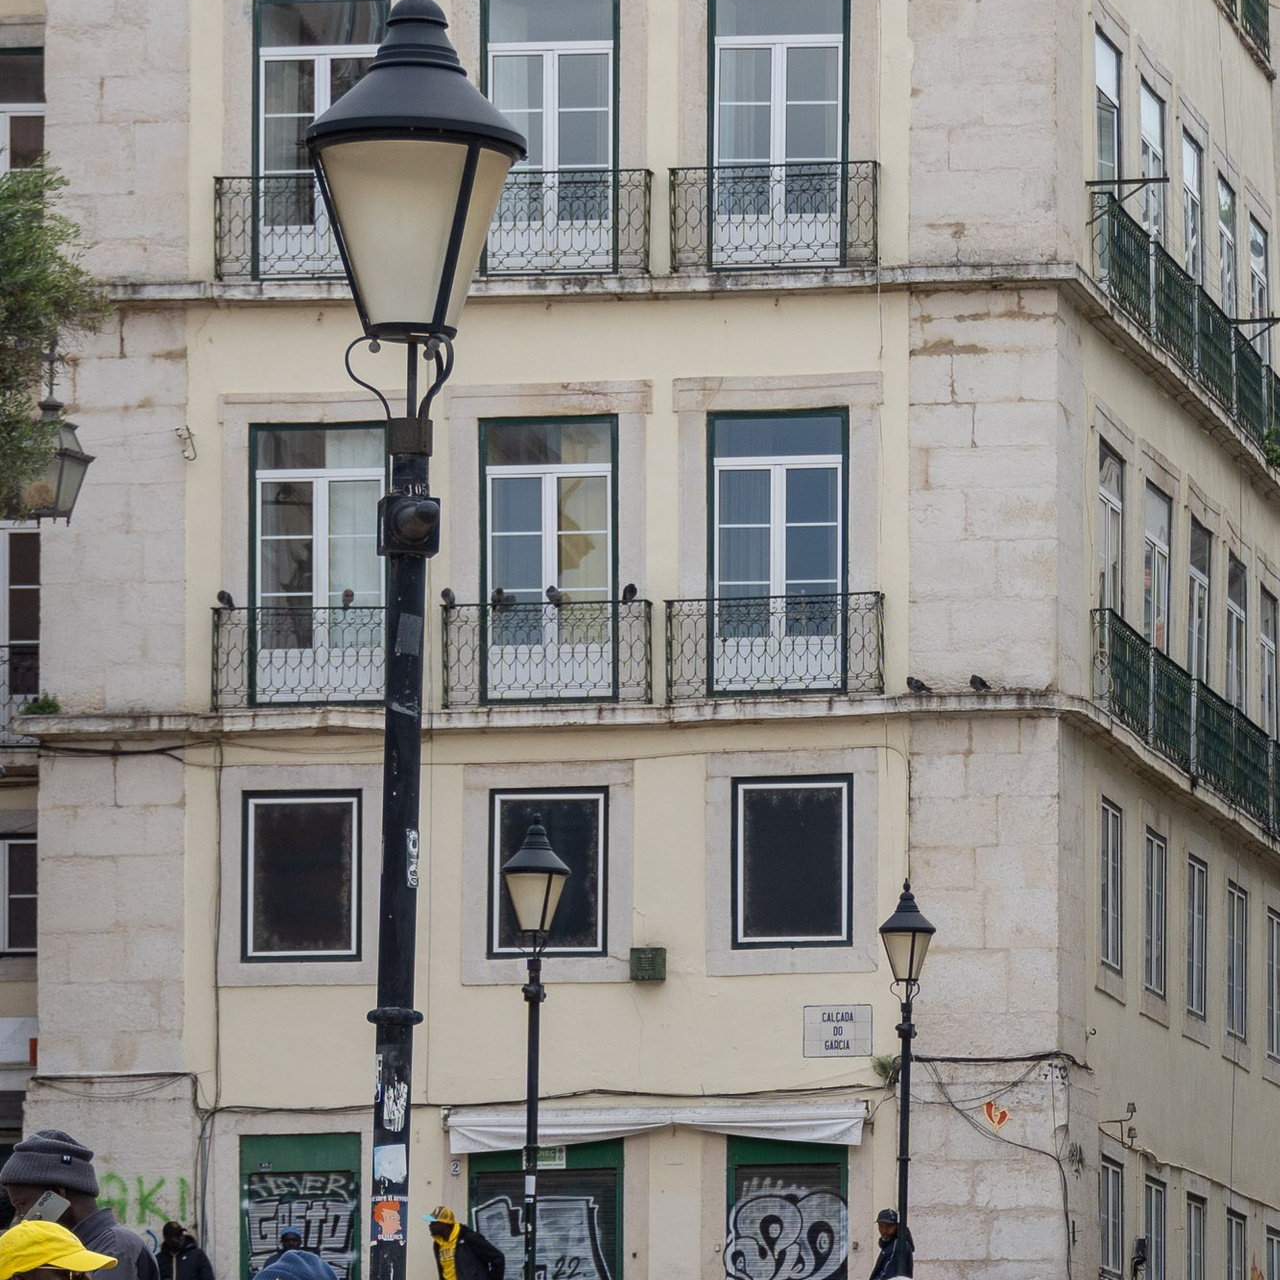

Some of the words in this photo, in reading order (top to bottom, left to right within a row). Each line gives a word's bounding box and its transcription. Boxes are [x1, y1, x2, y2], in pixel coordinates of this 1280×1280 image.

[822, 1011, 854, 1024] CALÇADA
[833, 1026, 843, 1036] DO
[824, 1040, 850, 1050] GARCIA
[452, 1160, 460, 1175] 2
